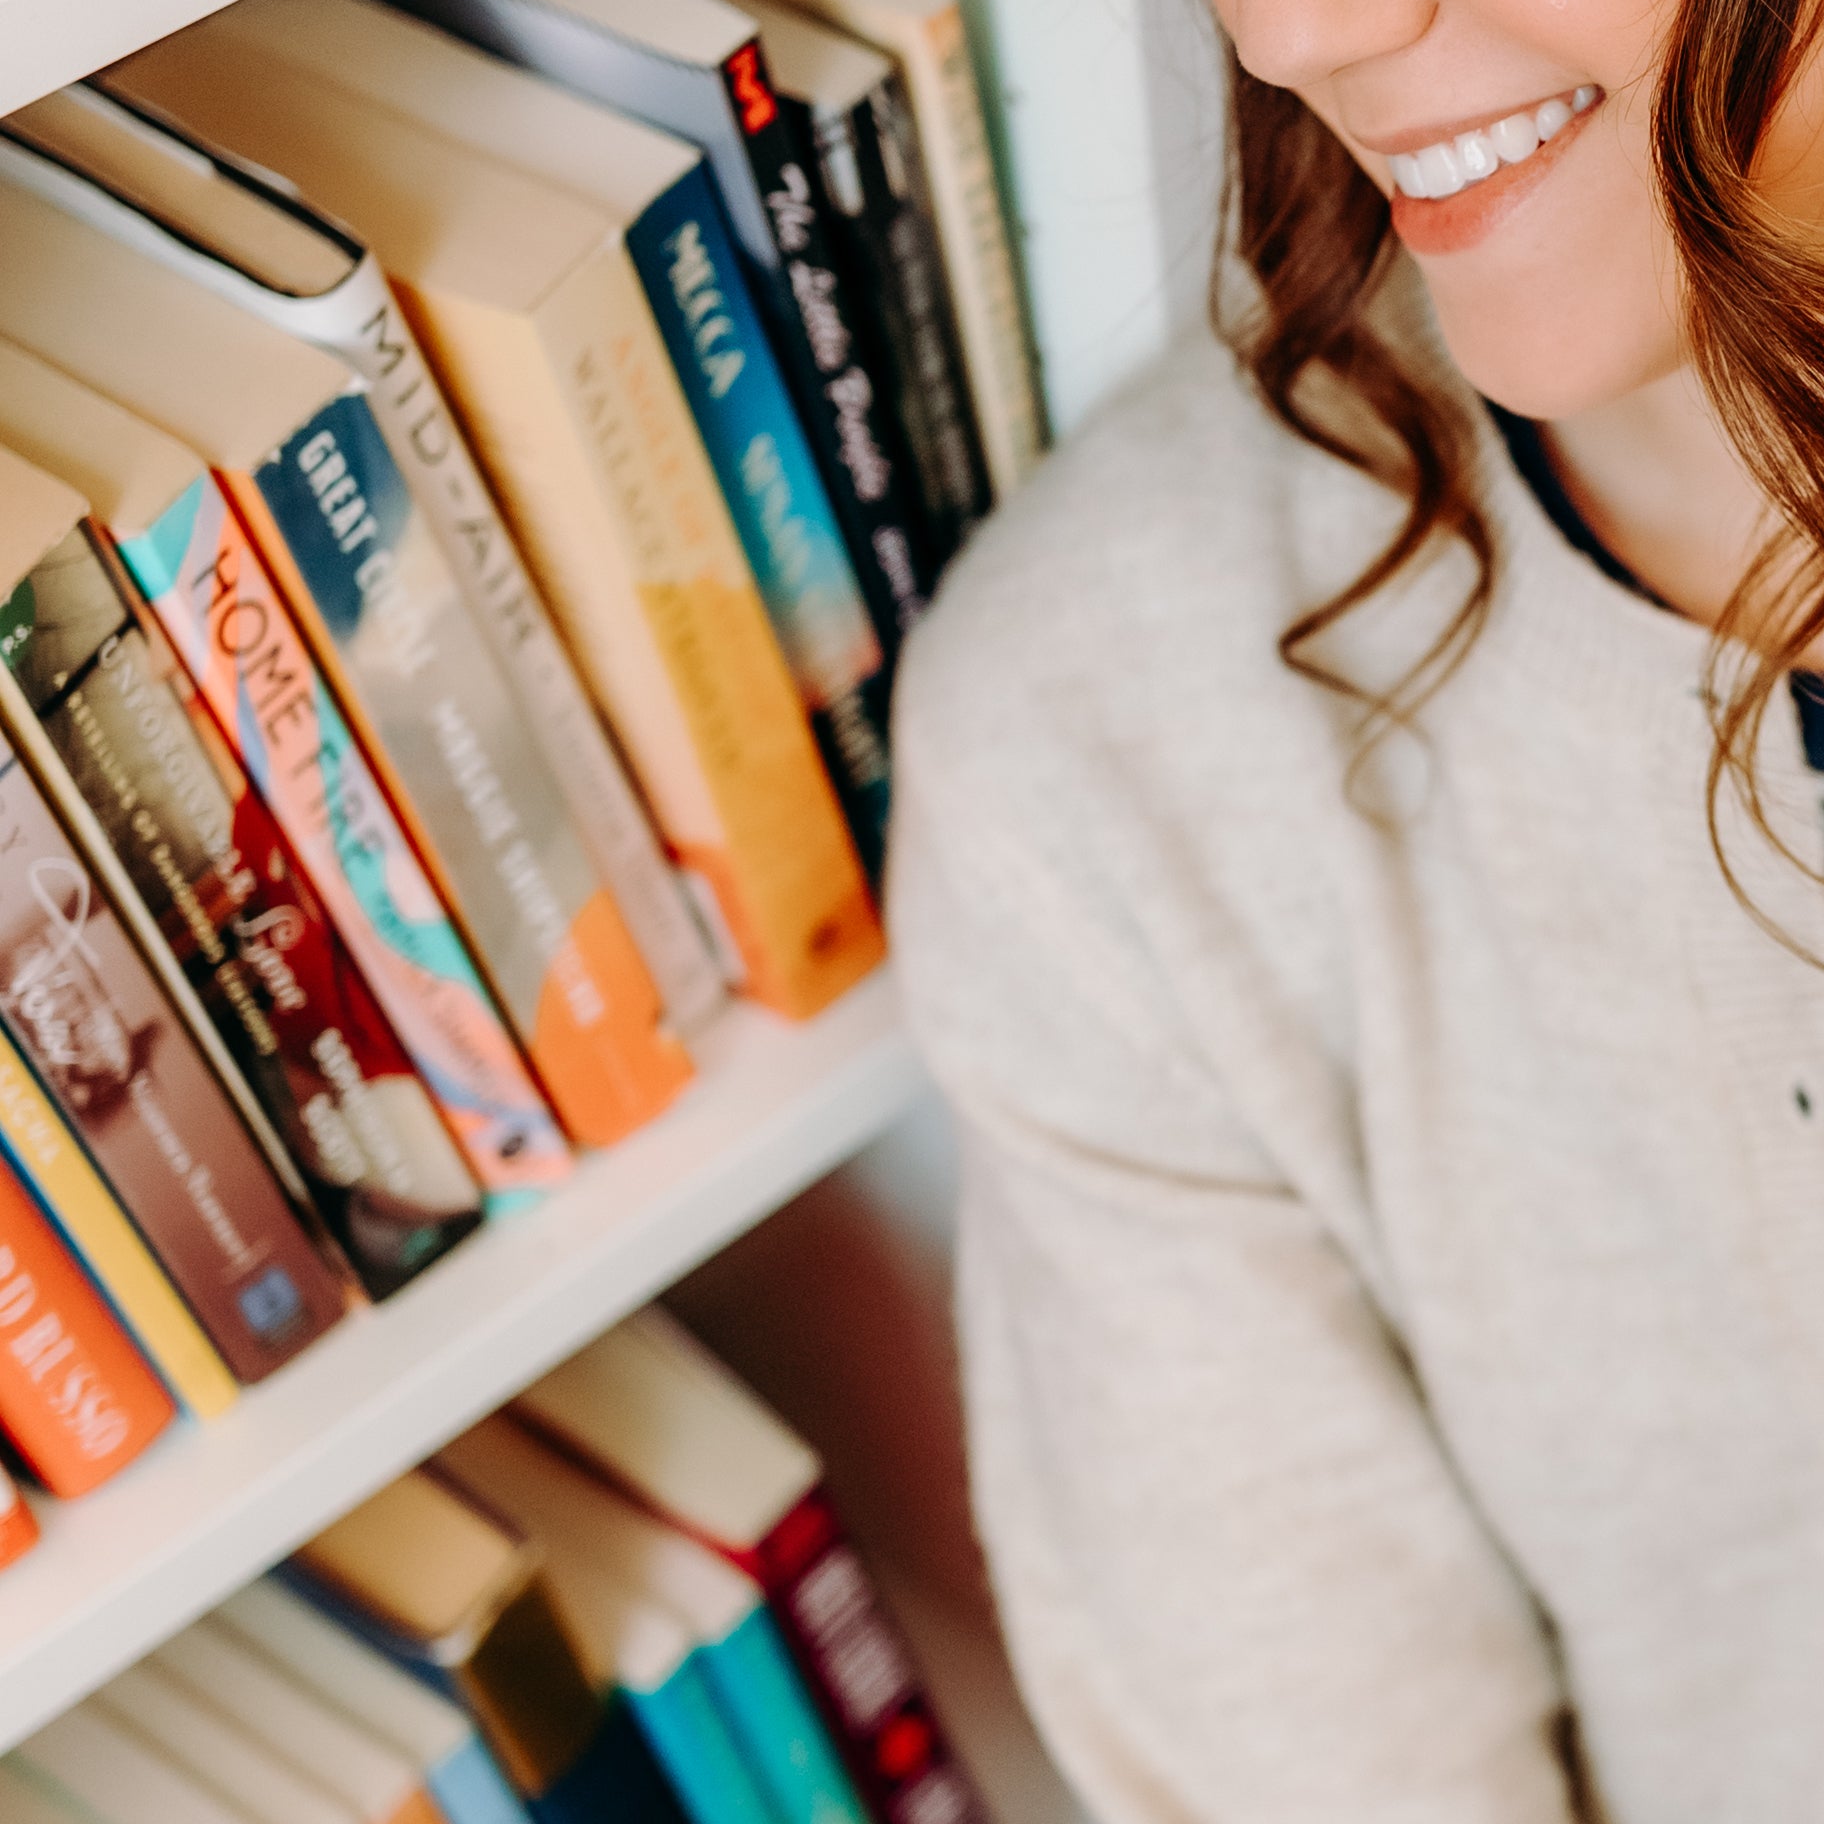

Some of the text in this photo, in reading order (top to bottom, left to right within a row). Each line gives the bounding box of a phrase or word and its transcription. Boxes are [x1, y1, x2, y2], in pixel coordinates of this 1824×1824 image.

[663, 218, 748, 402] MECCA
[296, 427, 379, 554] GREAT
[188, 546, 319, 749] HOME
